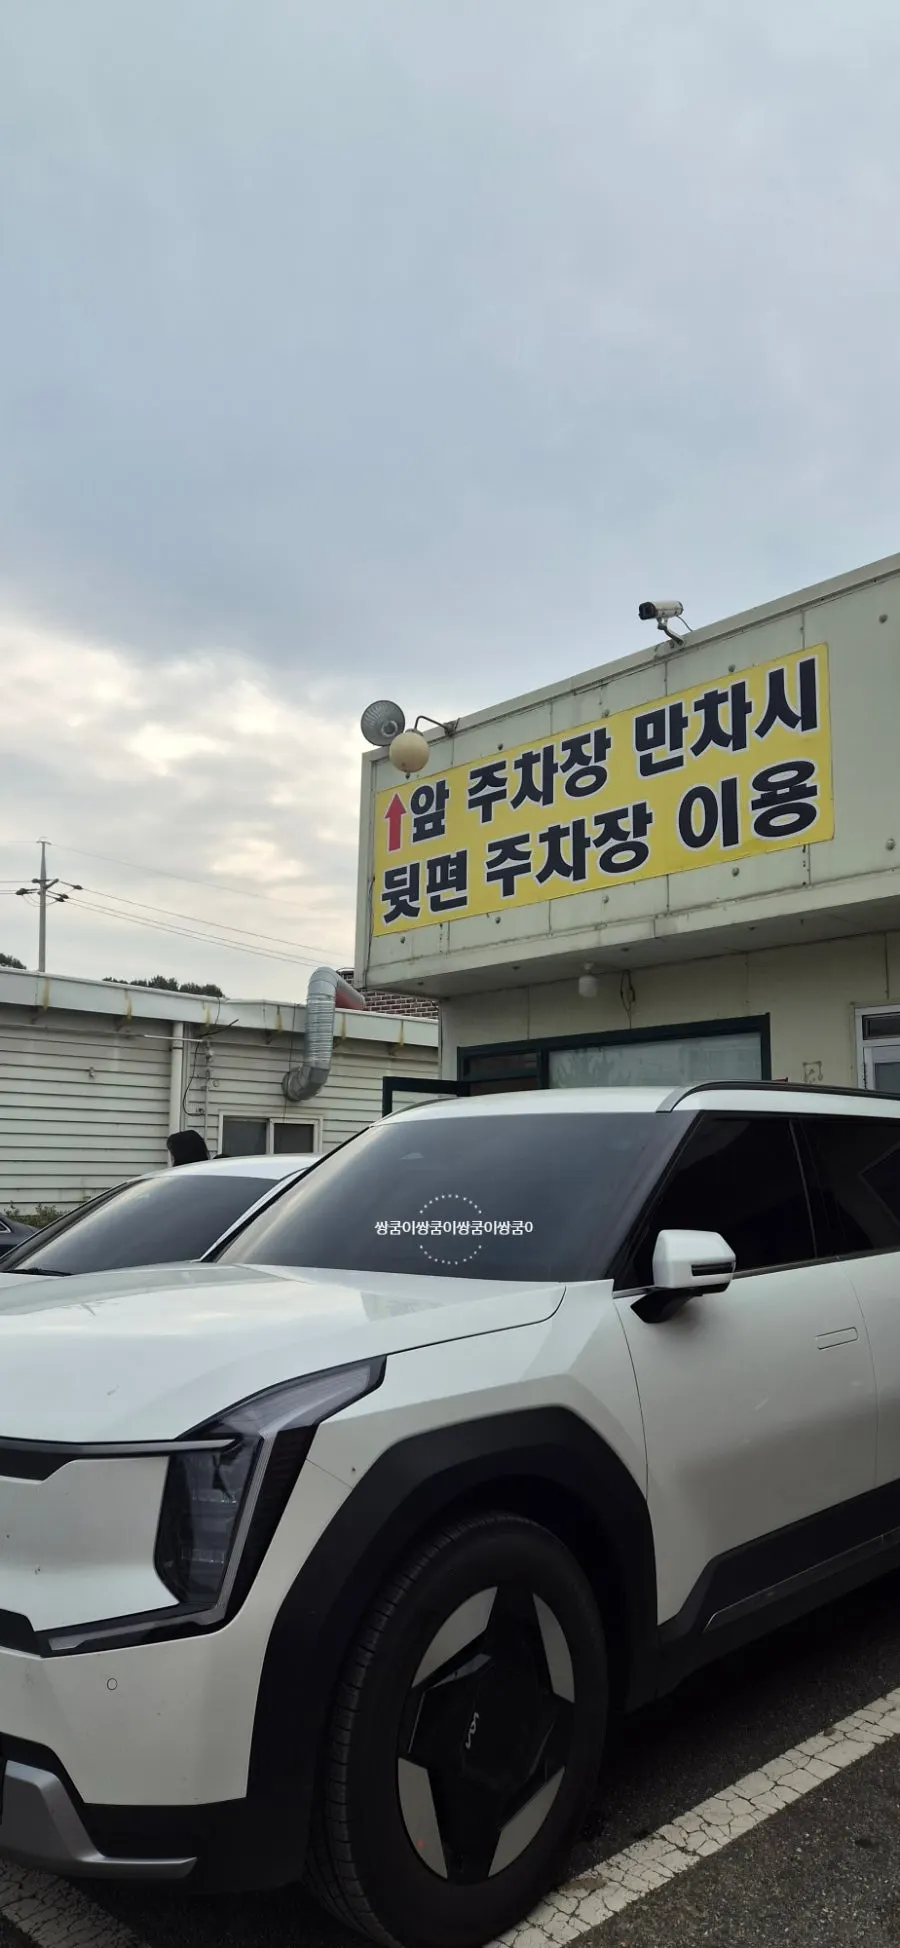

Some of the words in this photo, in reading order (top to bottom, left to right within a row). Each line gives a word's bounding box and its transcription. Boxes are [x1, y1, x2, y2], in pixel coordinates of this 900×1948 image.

[409, 780, 450, 843] 앞
[467, 727, 611, 824] 주차장
[634, 658, 818, 778] 만차시
[381, 850, 468, 924] 뒷편
[485, 801, 653, 897] 주차장
[678, 760, 818, 849] 이용
